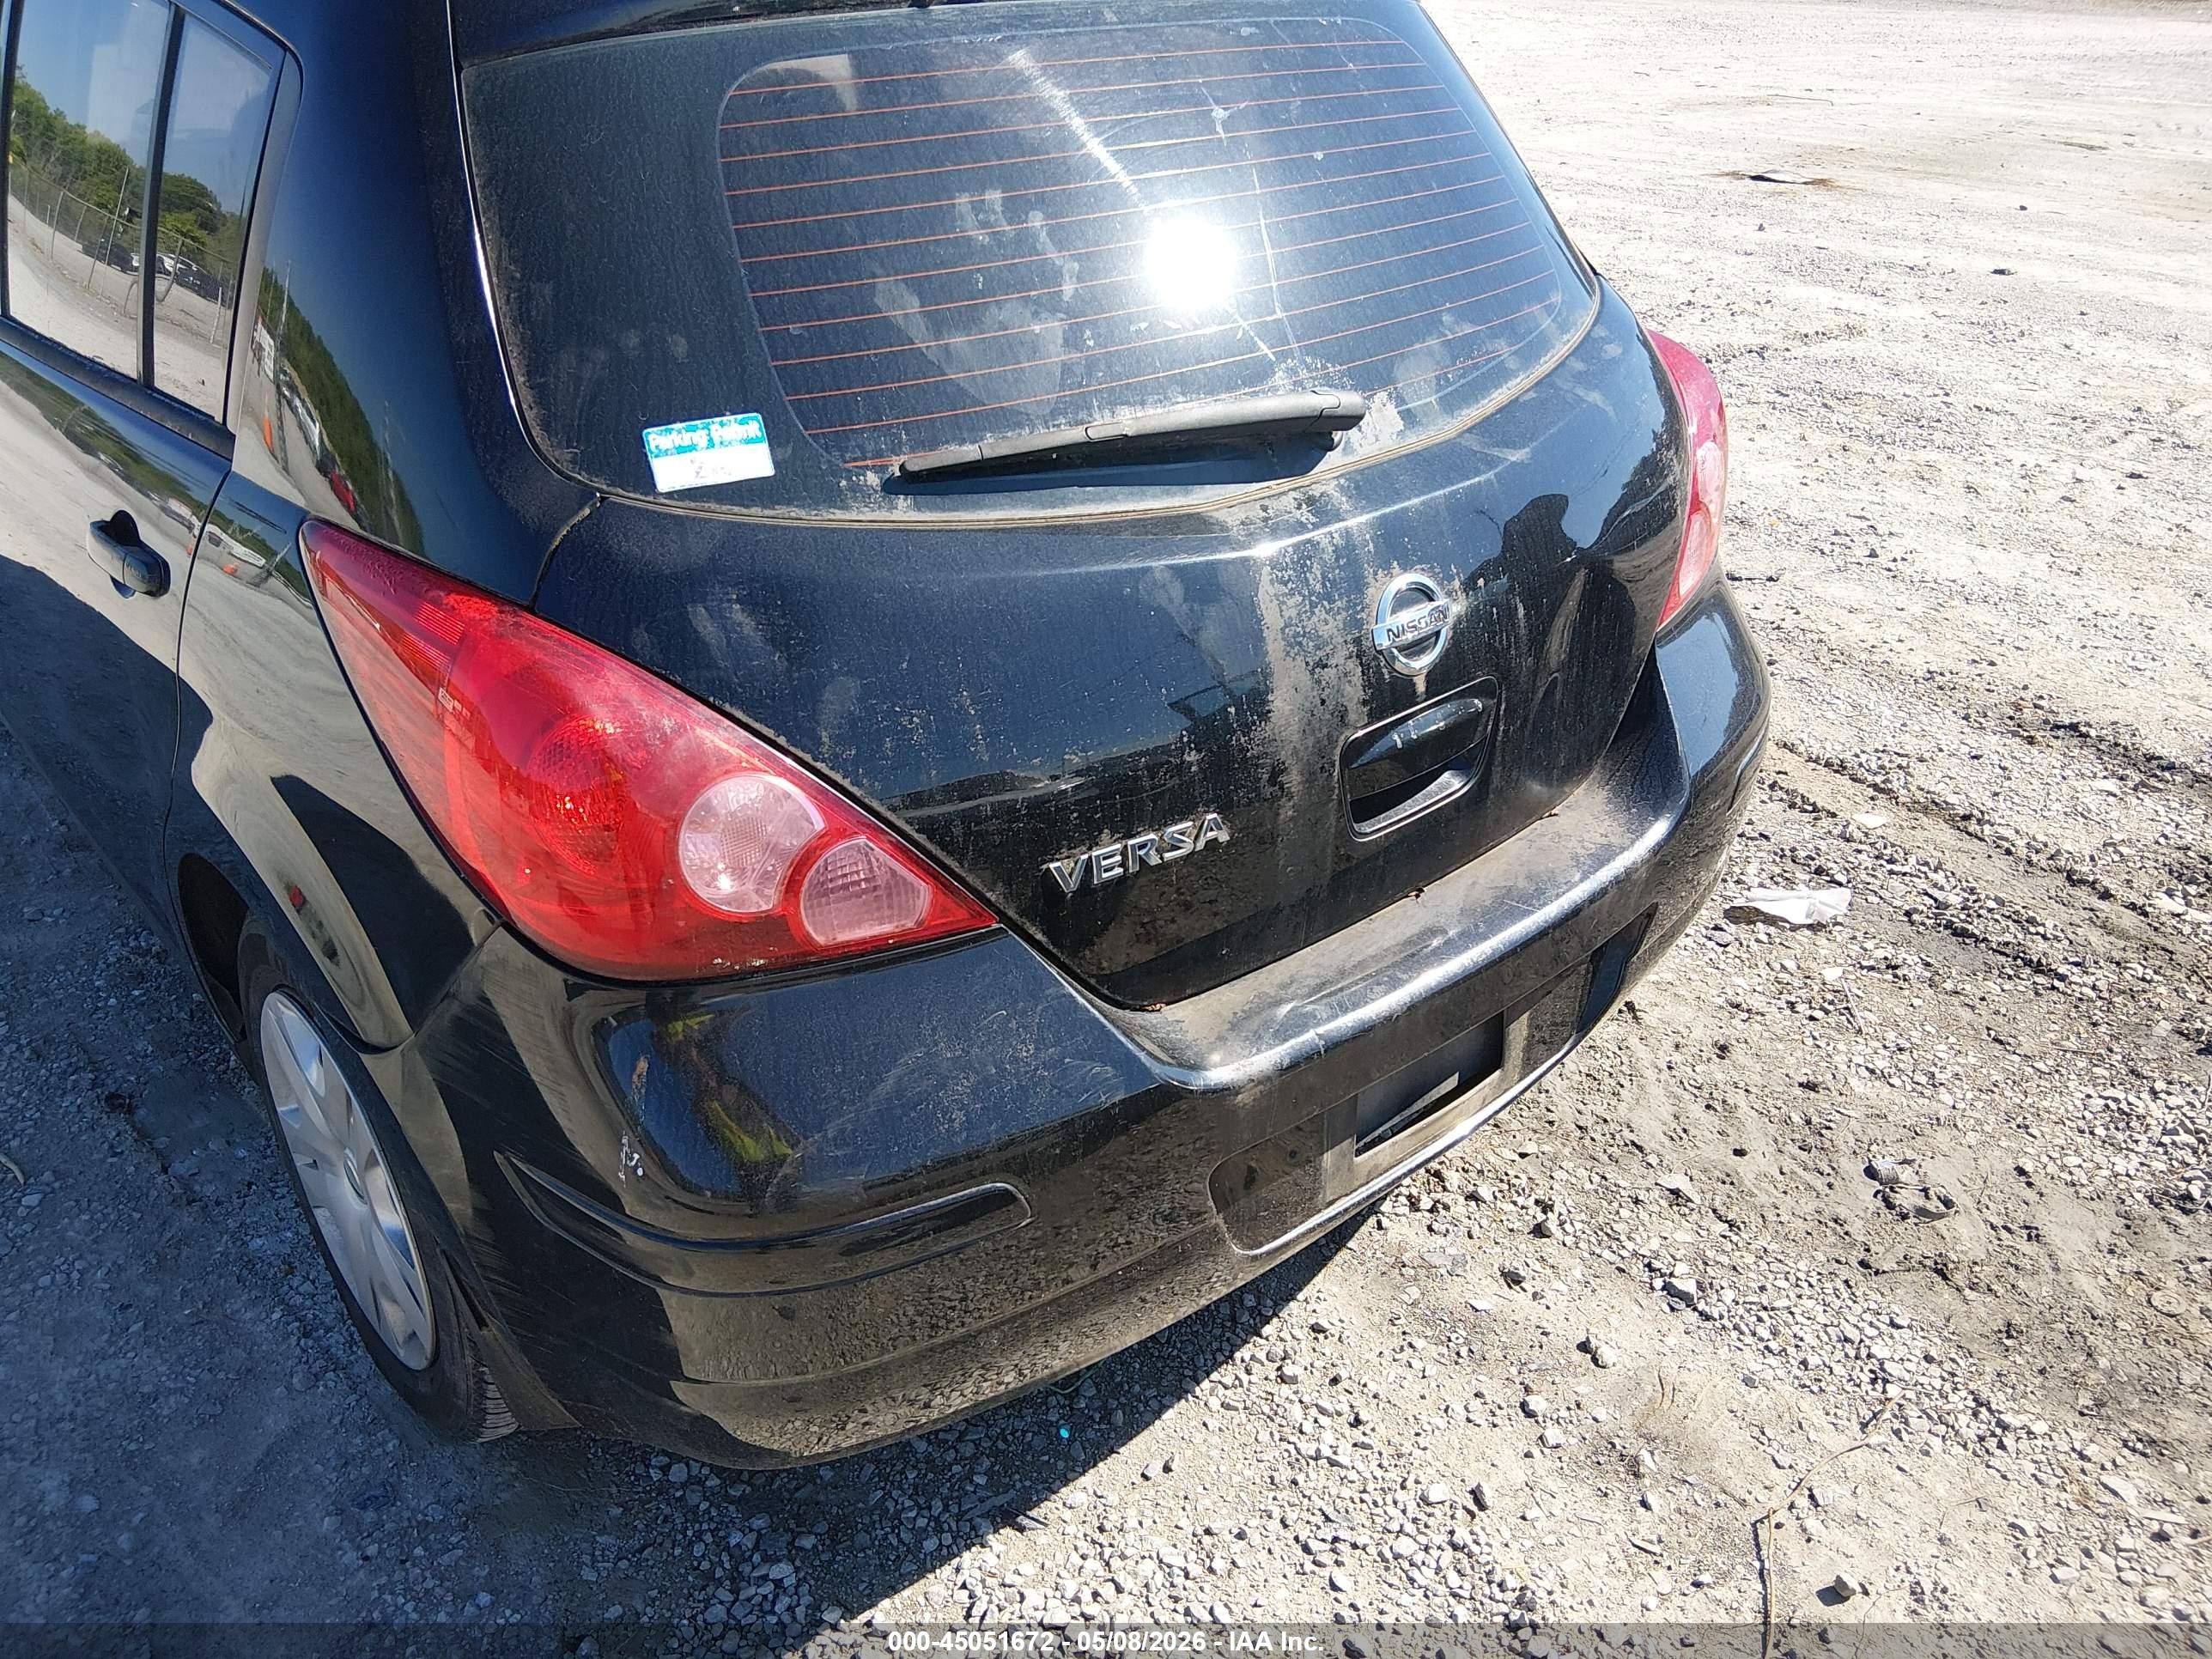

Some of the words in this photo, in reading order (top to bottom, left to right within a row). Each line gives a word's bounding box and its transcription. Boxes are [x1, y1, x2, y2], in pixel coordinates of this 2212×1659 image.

[647, 429, 708, 453] Parking
[1386, 603, 1449, 642] NISSAN
[1048, 812, 1230, 893] VERSA
